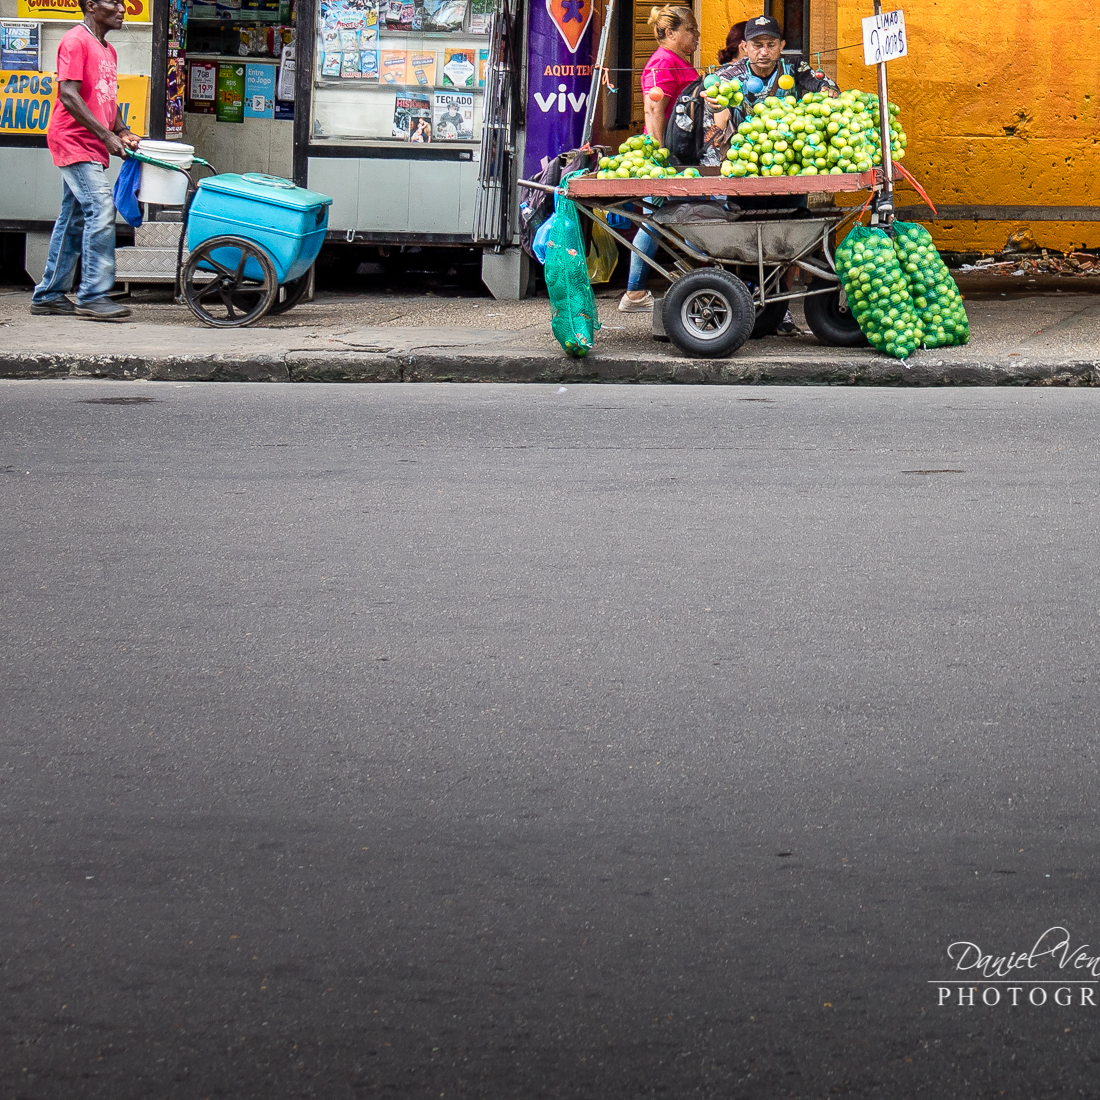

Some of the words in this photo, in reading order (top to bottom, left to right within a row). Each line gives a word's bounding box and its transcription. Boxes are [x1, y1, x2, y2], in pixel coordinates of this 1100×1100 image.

[248, 68, 264, 77] Entre
[543, 65, 575, 77] AQUI
[576, 65, 593, 76] TEM
[4, 74, 57, 96] APOS
[256, 76, 272, 86] Jogo
[435, 95, 473, 106] TECLADO
[0, 98, 51, 131] ANCO
